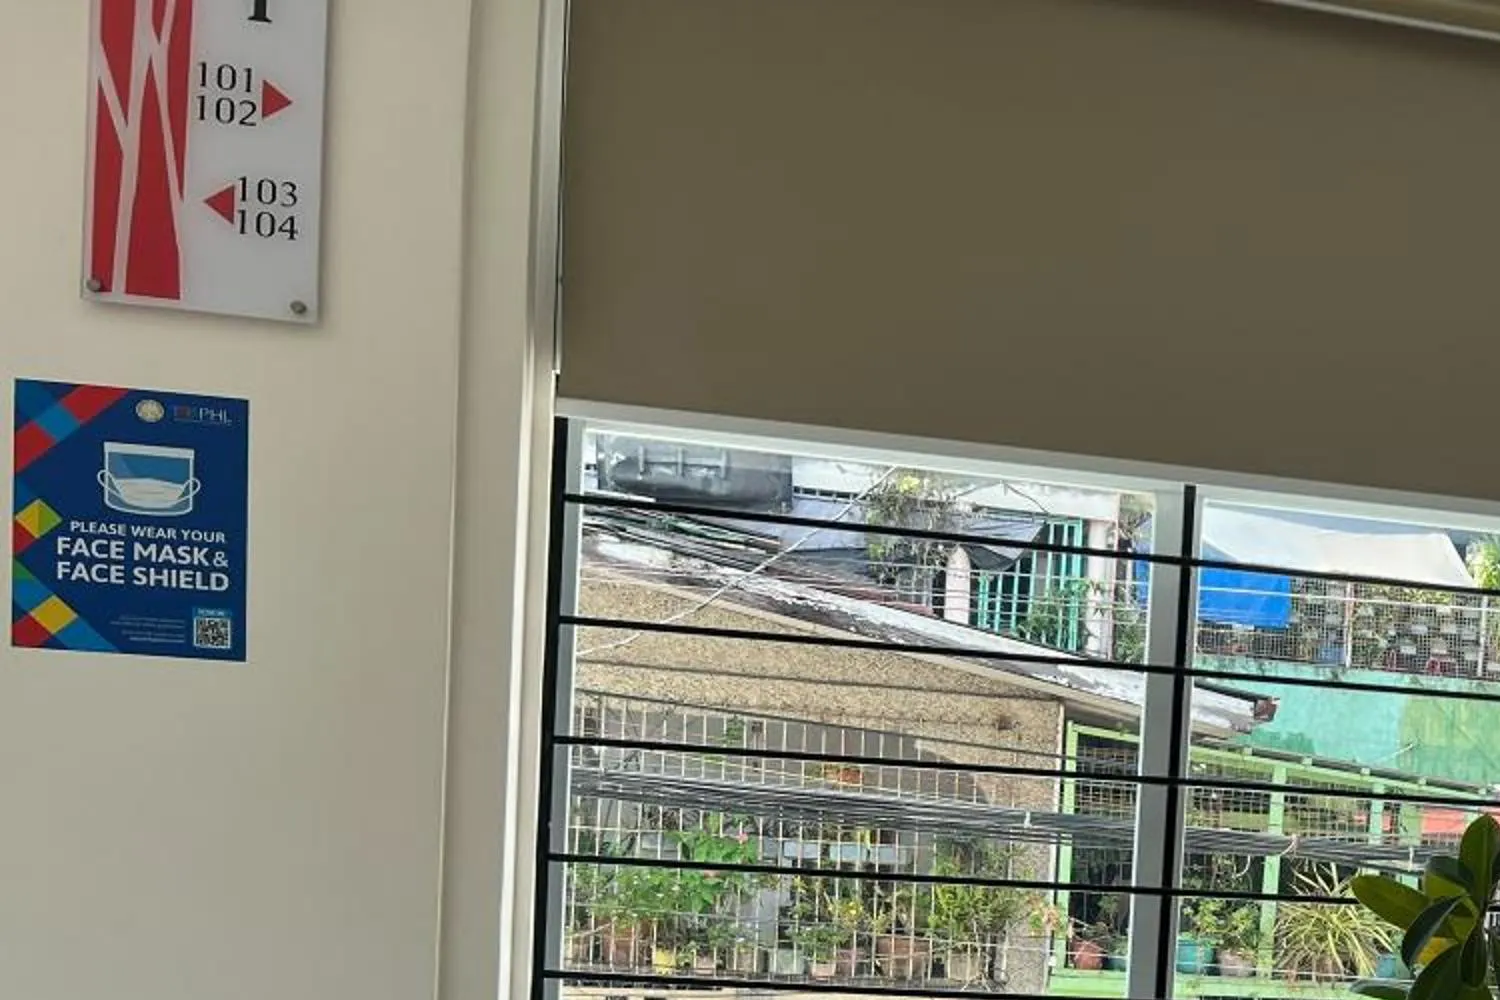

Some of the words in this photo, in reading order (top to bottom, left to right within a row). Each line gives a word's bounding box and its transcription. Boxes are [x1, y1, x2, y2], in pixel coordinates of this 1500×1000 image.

[197, 61, 253, 94] 101
[195, 95, 258, 127] 102
[237, 176, 299, 208] 103
[236, 209, 300, 241] 104
[70, 521, 127, 536] PLEASE
[131, 525, 177, 540] WEAR
[181, 529, 226, 544] YOUR
[57, 536, 125, 560] FACE
[133, 542, 209, 567] MASK
[212, 551, 229, 568] &
[57, 561, 125, 585] FACE
[133, 567, 229, 592] SHIELD
